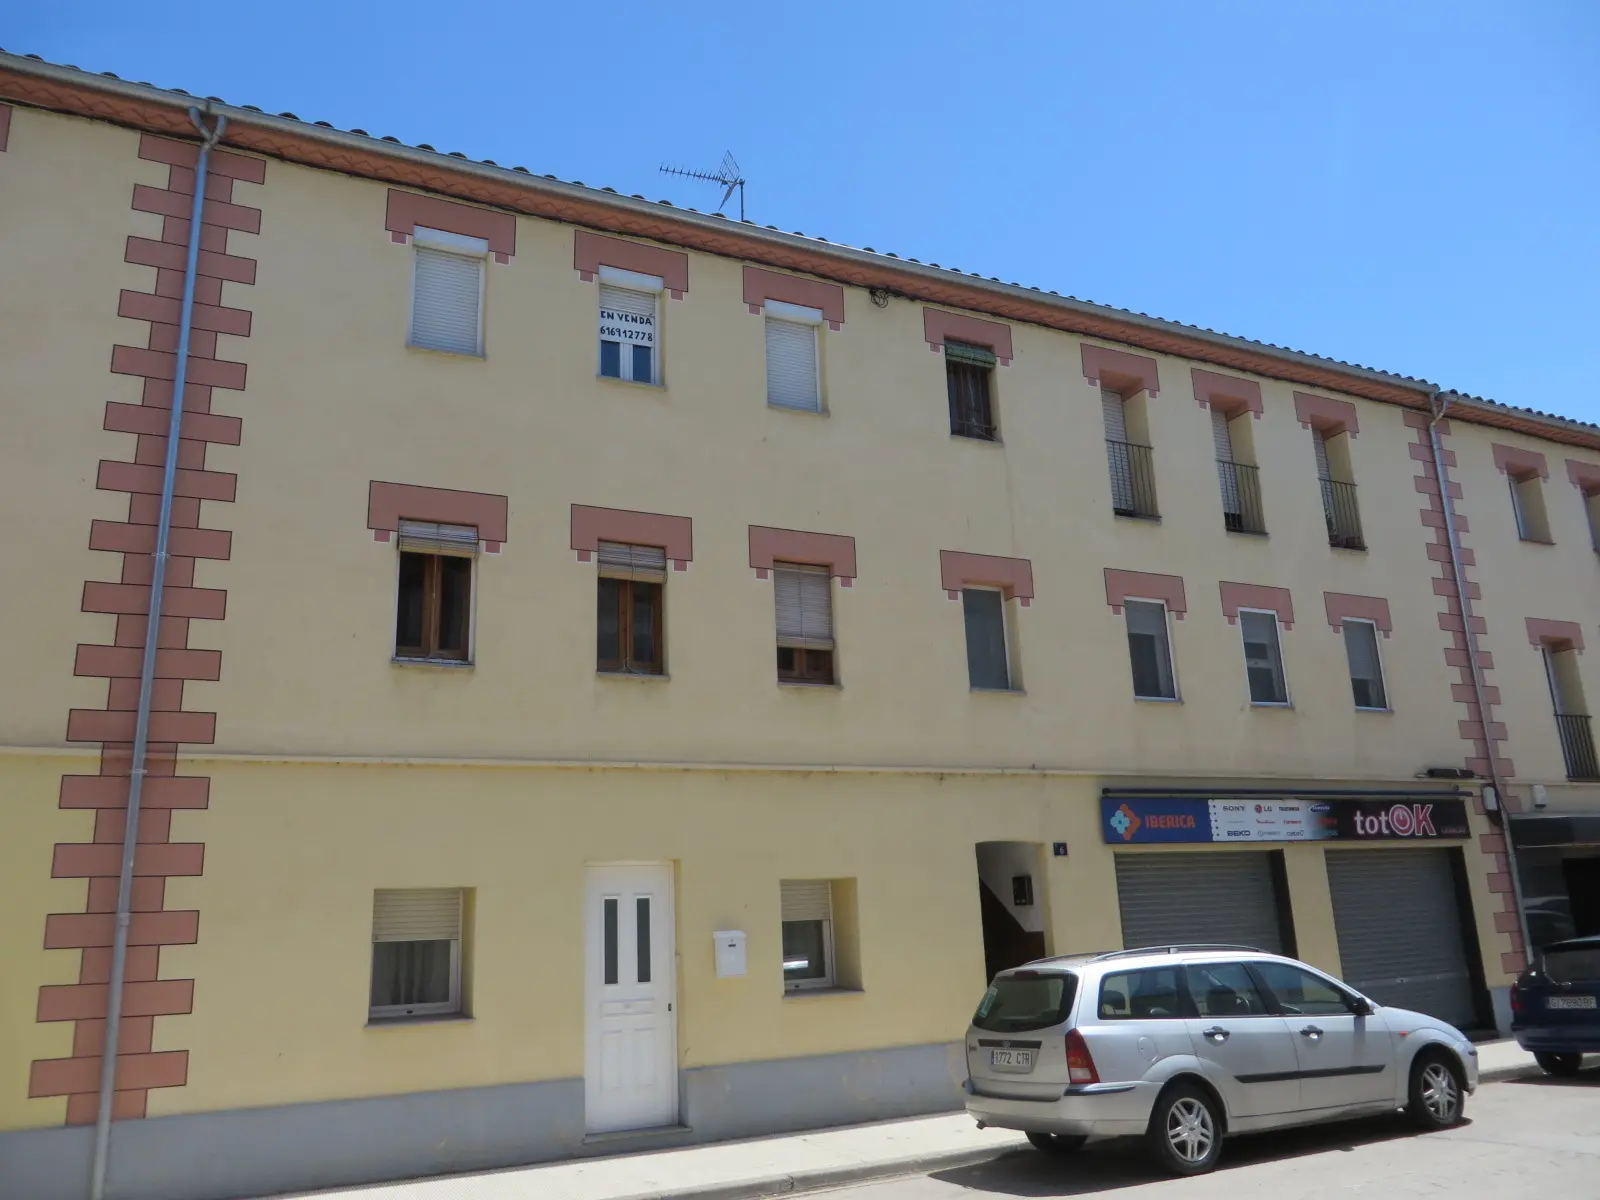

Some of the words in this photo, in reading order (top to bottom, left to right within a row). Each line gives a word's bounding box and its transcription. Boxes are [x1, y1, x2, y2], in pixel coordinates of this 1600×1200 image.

[600, 311, 614, 320] EN
[617, 313, 653, 326] VENDA
[600, 326, 653, 341] 616912778
[1354, 804, 1437, 836] totOK
